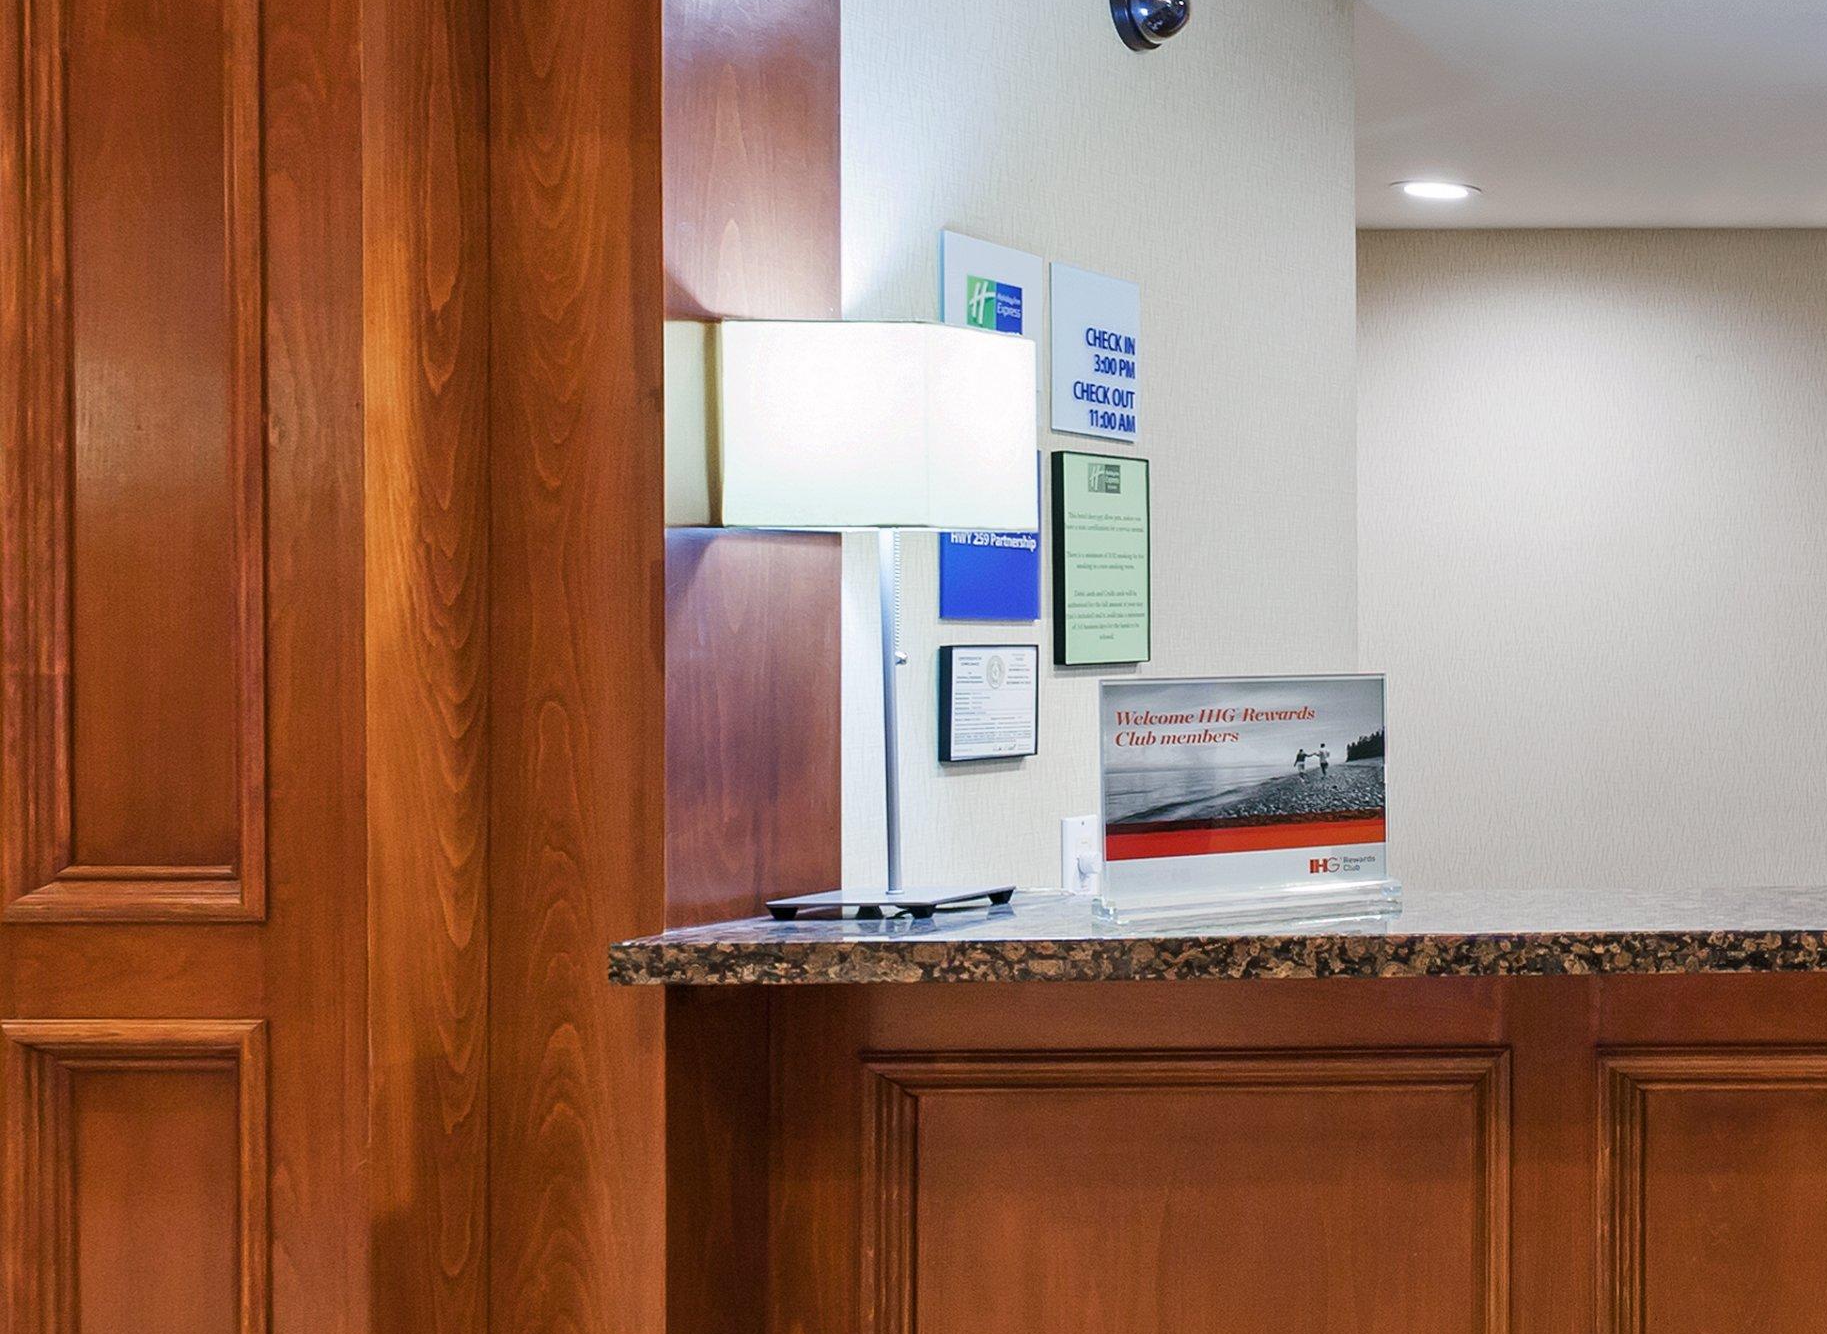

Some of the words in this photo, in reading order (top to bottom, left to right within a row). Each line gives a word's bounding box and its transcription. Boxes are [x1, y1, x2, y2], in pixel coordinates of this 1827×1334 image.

[1085, 328, 1122, 352] CHECK
[1124, 336, 1135, 356] IN
[1094, 354, 1117, 375] 3:00
[1119, 358, 1135, 379] PM
[1073, 381, 1110, 405] CHECK
[1112, 388, 1135, 409] OUT
[1089, 409, 1117, 430] 11:00
[1118, 413, 1135, 433] AM
[950, 532, 972, 544] HWY
[973, 532, 989, 545] 259
[990, 533, 1037, 552] Partnership
[1115, 710, 1194, 726] Welcome
[1198, 708, 1236, 724] IHG
[1241, 706, 1316, 722] Rewards
[1115, 730, 1156, 747] Club
[1160, 729, 1239, 746] members
[1309, 856, 1340, 874] IHG
[1343, 855, 1376, 863] Rewards
